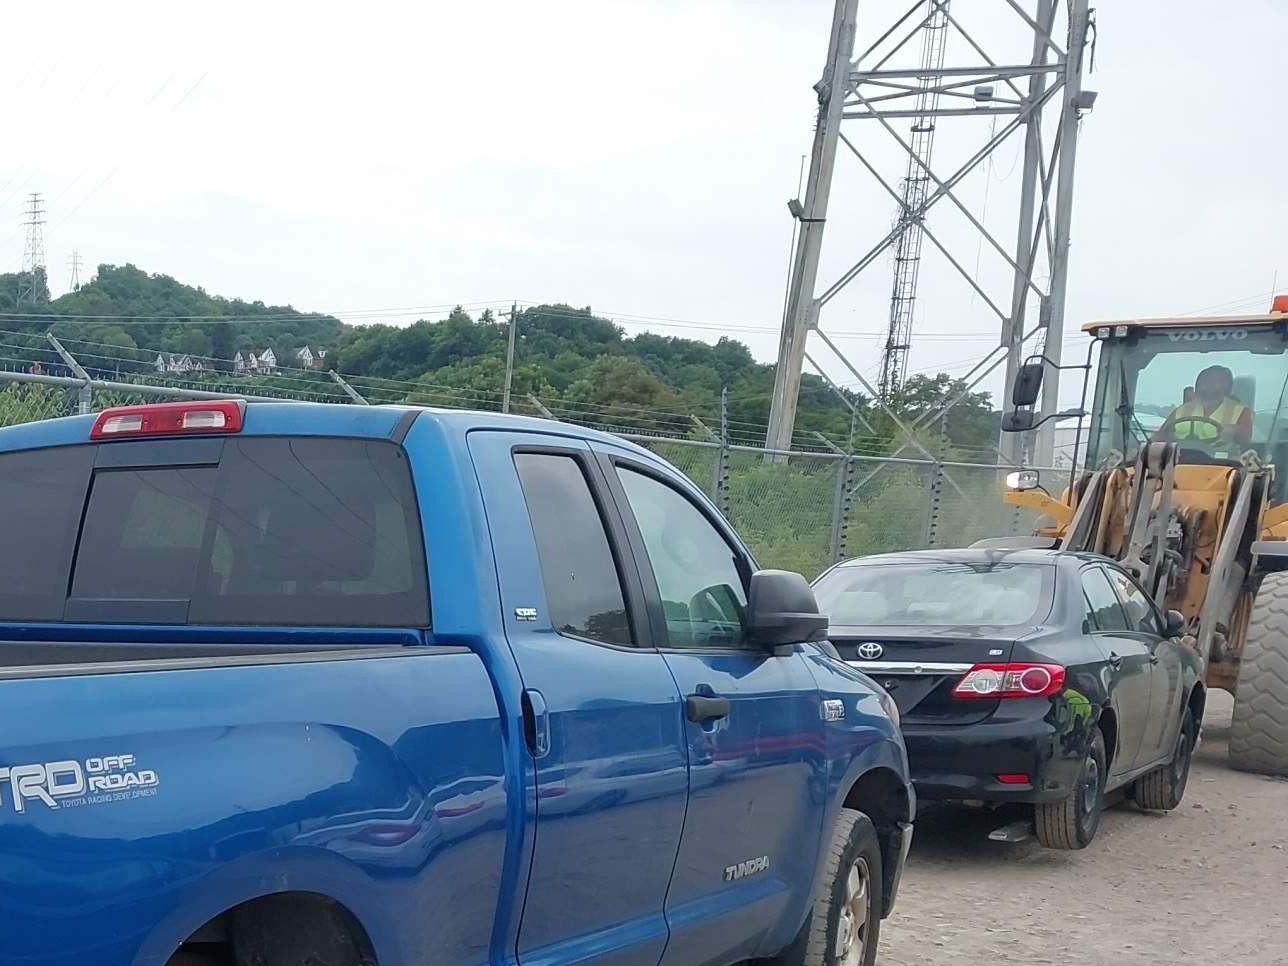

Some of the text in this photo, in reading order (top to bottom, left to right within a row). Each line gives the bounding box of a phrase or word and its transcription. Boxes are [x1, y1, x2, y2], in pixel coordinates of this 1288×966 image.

[1168, 328, 1249, 343] VOLVO
[86, 755, 136, 772] OFF
[88, 770, 159, 793] ROAD
[725, 856, 770, 881] TUNDRA
